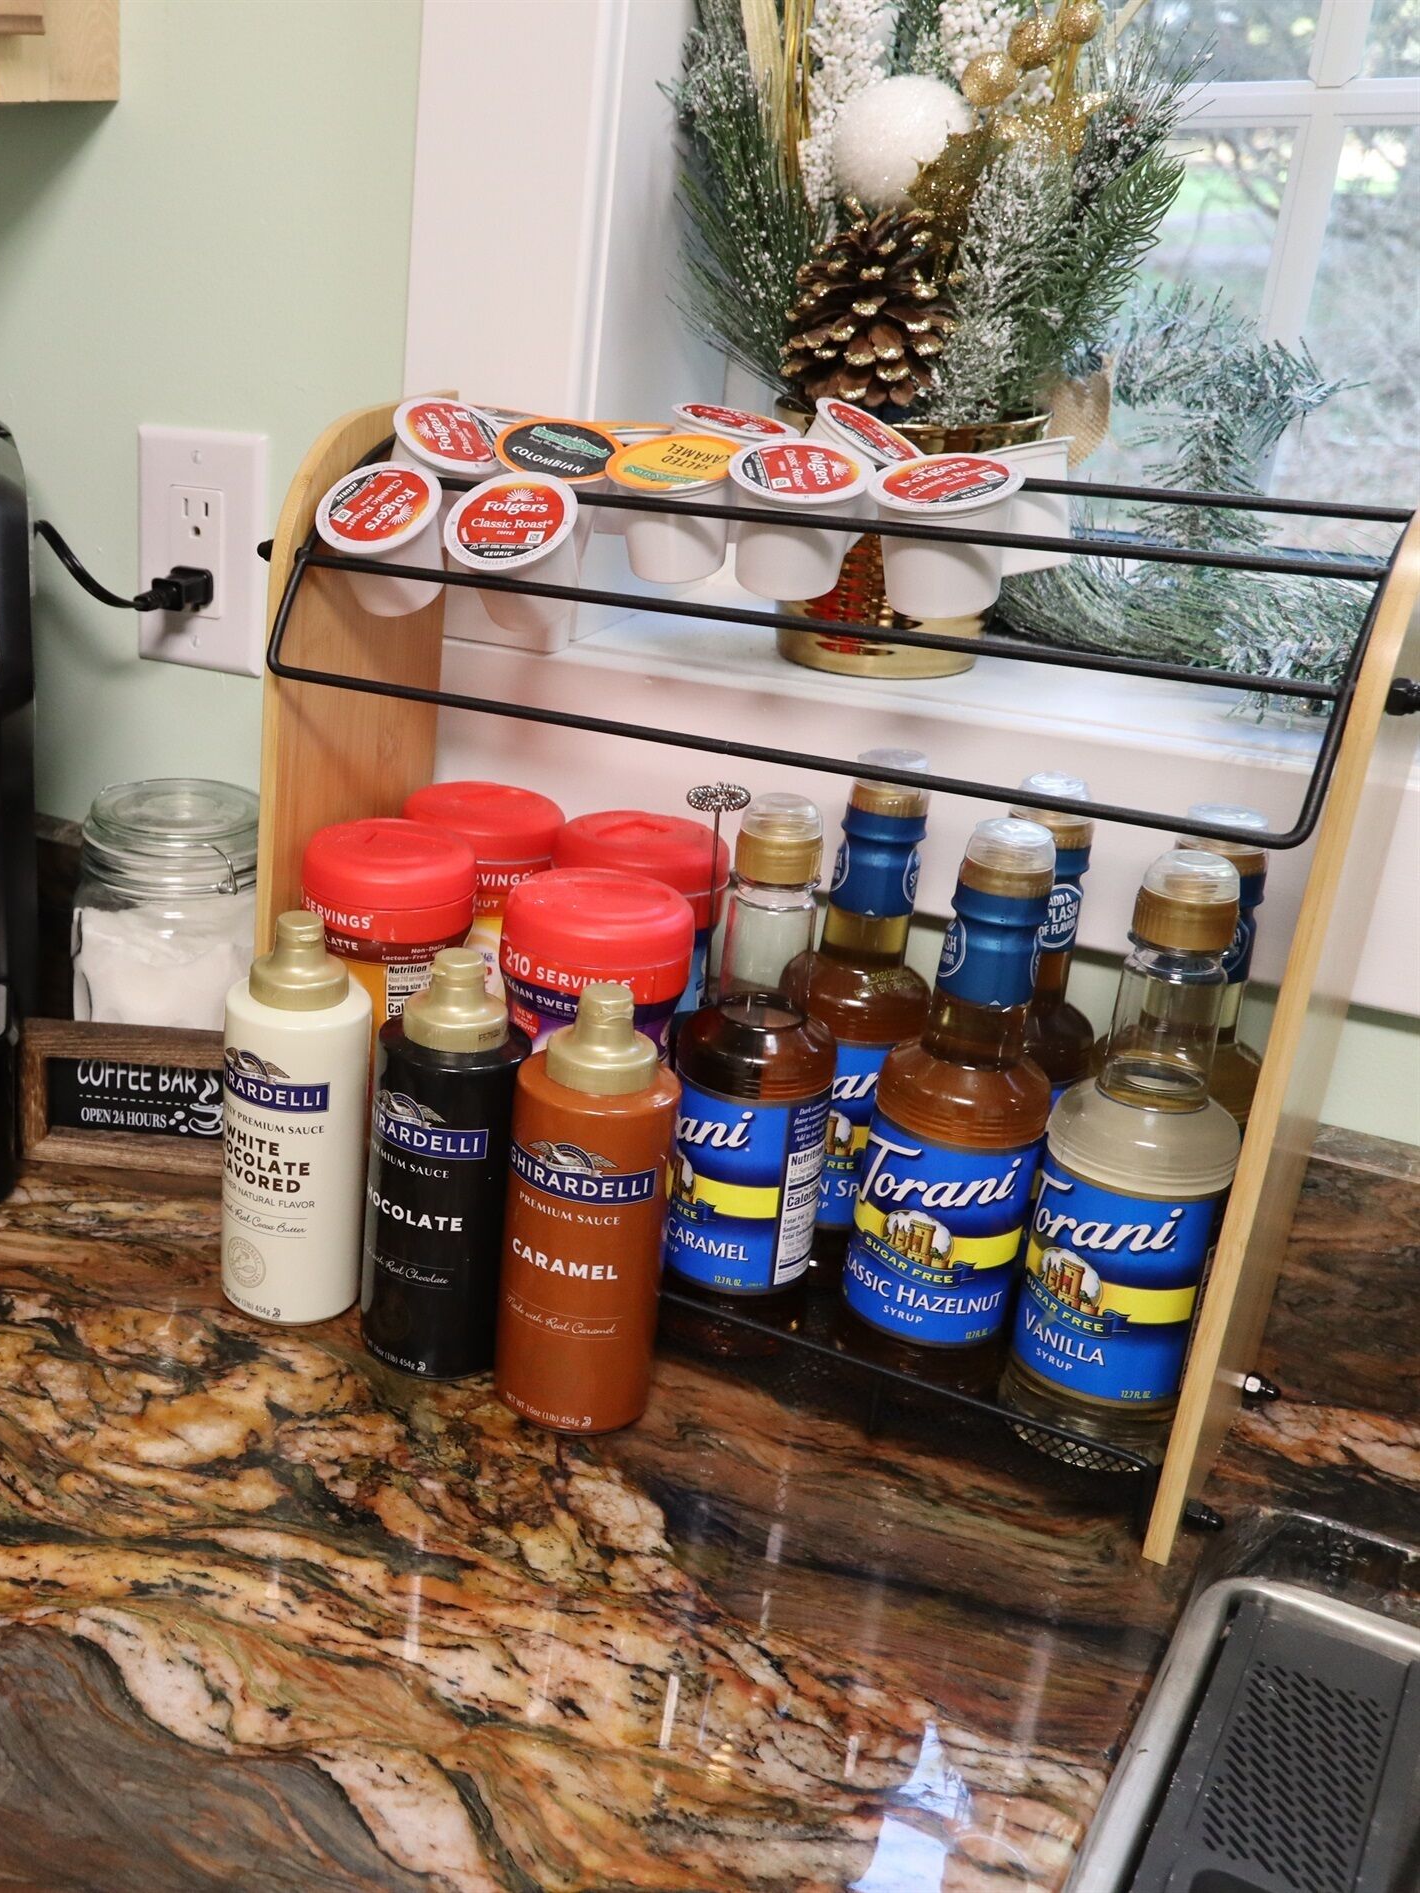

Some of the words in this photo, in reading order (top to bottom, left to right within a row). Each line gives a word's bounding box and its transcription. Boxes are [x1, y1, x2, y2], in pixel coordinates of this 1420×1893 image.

[511, 445, 585, 474] COLOMBIAN
[661, 455, 712, 471] SALTED
[667, 443, 731, 464] CARAMEL
[897, 461, 970, 488] Folgers
[908, 476, 953, 496] Classic
[374, 479, 403, 506] Classic
[348, 506, 375, 528] Roast
[365, 488, 418, 531] Folgers
[482, 500, 548, 515] Folgers
[471, 518, 512, 529] Classic
[514, 519, 547, 529] Roast
[477, 872, 530, 887] VINGS
[1048, 901, 1078, 924] PLASH
[324, 935, 359, 951] LATTE
[388, 965, 427, 974] Nutrition
[506, 946, 530, 976] 210
[536, 994, 578, 1012] SWEET
[77, 1059, 152, 1092] COFFEE
[159, 1066, 197, 1094] BAR
[81, 1107, 112, 1124] OPEN
[113, 1110, 124, 1124] 24
[126, 1111, 167, 1128] HOURS
[237, 1112, 285, 1134] PREMIUM
[288, 1125, 325, 1135] SAUCE
[226, 1120, 280, 1157] WHITE
[375, 1108, 479, 1153] IRARDELLI
[676, 1112, 754, 1148] ani
[225, 1139, 310, 1176] OCOLATE
[409, 1163, 450, 1179] SAUCE
[511, 1145, 649, 1198] GHIRARDELLI
[859, 1132, 1023, 1208] Torani
[238, 1187, 276, 1207] NATURAL
[278, 1200, 315, 1209] FLAVOR
[367, 1184, 463, 1232] HOCOLATE
[519, 1190, 572, 1222] PREMIUM
[577, 1214, 621, 1226] SAUCE
[676, 1203, 698, 1220] REE
[1032, 1169, 1183, 1252] Torani
[276, 1222, 307, 1233] Butter
[668, 1217, 750, 1261] CARAMEL
[512, 1237, 618, 1280] CARAMEL
[865, 1237, 908, 1270] SUGAR
[912, 1269, 953, 1284] FREE
[385, 1260, 405, 1275] Real
[405, 1267, 449, 1284] Chocolate
[847, 1252, 892, 1298] LASSIC
[896, 1284, 1002, 1314] HAZELNUT
[883, 1305, 923, 1323] SYRUP
[1026, 1273, 1059, 1313] SUGAR
[1061, 1311, 1104, 1333] FREE
[545, 1317, 569, 1332] Real
[571, 1322, 616, 1335] Caramel
[1025, 1307, 1105, 1366] VANILLA
[399, 1358, 416, 1370] 454g
[1036, 1347, 1073, 1372] SYRUP
[526, 1404, 541, 1417] 16oz
[542, 1411, 560, 1423] (1lb)
[560, 1416, 580, 1427] 454g
